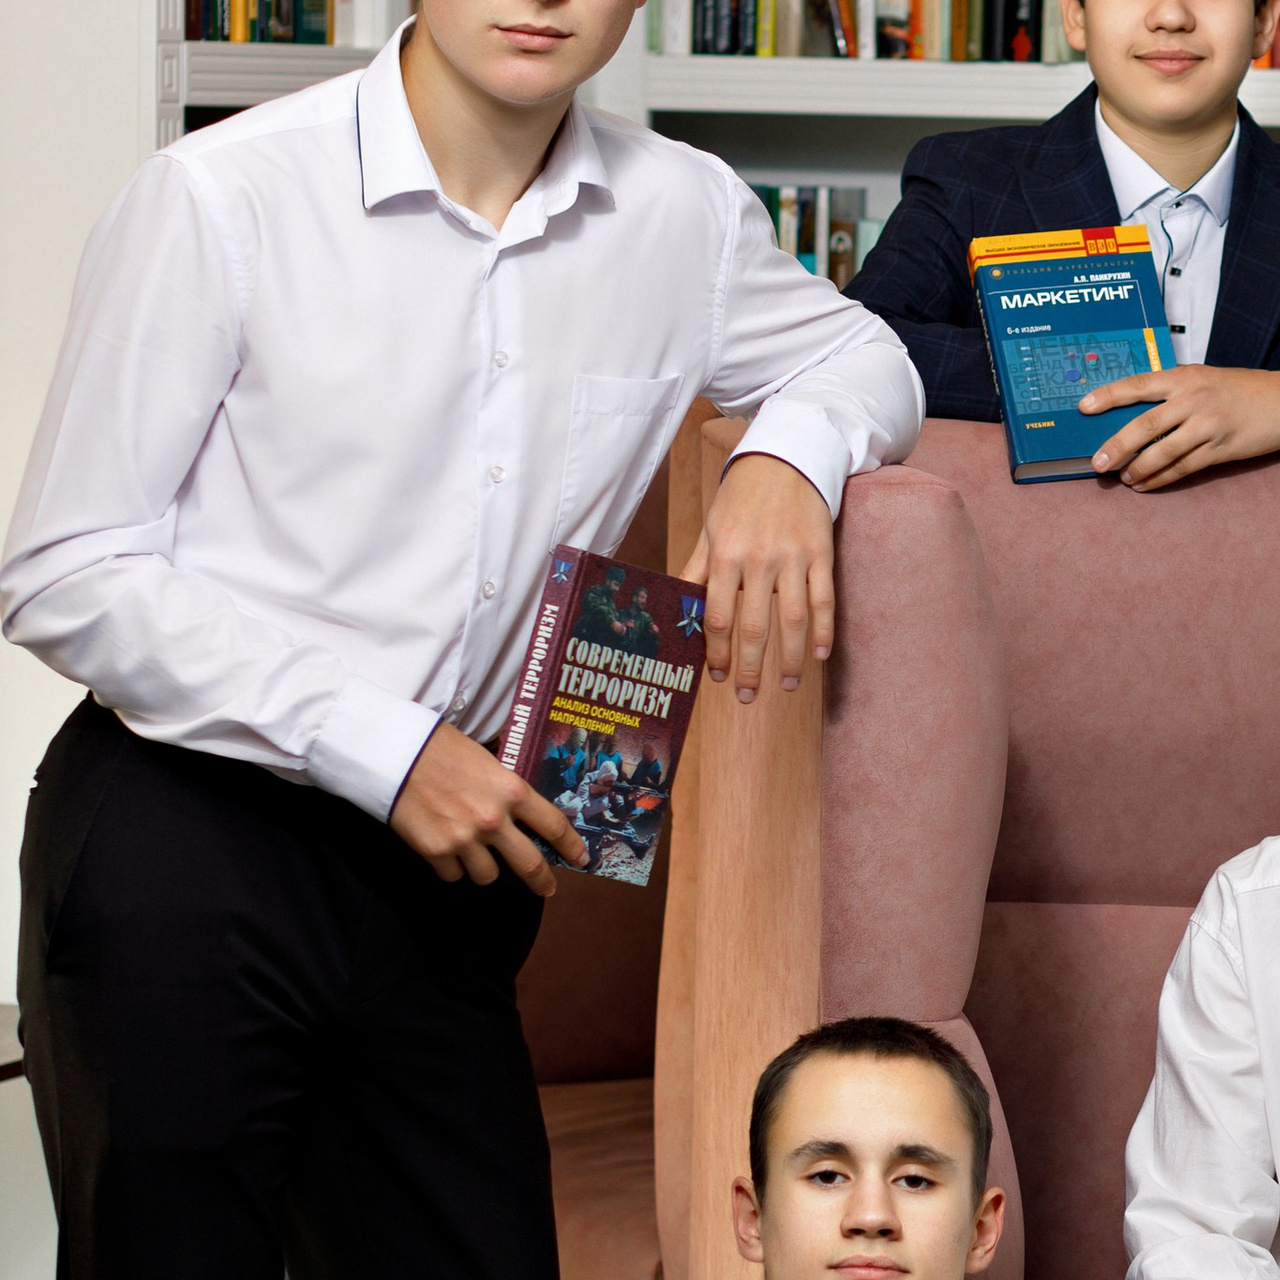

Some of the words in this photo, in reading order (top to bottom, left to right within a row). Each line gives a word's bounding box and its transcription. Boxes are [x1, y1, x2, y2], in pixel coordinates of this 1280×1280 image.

[1000, 285, 1134, 310] МАРКЕТИНГ
[1021, 324, 1052, 335] издание
[520, 603, 560, 701] ТЕРРОРИЗМ
[565, 637, 695, 694] СОВРЕМЕННЫЙ
[557, 663, 673, 720] ТЕРРОРИЗМ
[549, 709, 616, 736] НАПРАВЛЕНИЙ
[553, 697, 591, 718] АНАЛИЗ
[590, 705, 642, 729] ОСНОВНЫХ
